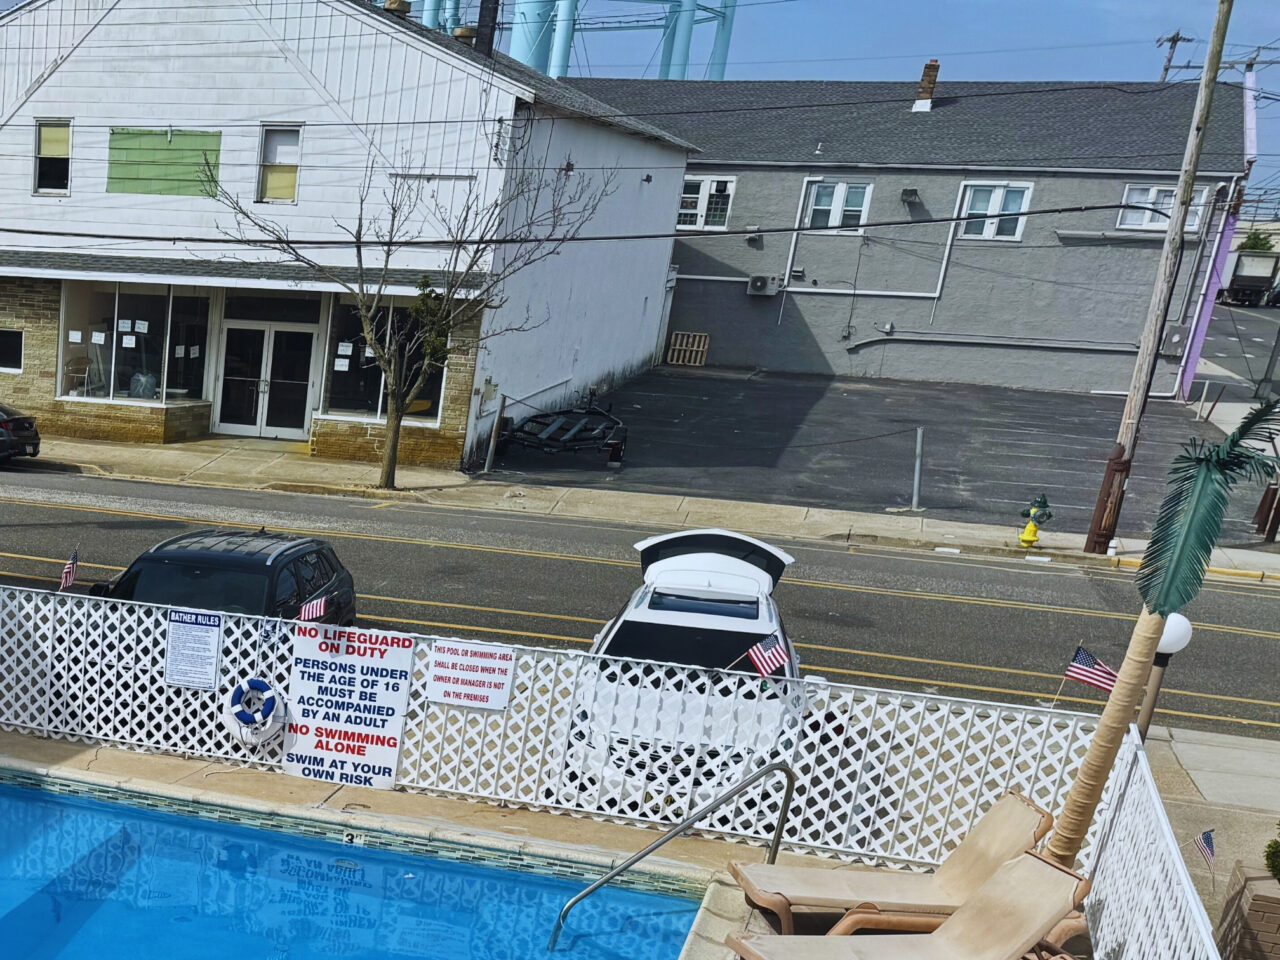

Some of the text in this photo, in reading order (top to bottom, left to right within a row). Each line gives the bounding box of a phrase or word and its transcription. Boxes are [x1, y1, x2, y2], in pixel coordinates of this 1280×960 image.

[170, 611, 219, 626] BATHER RULES
[297, 625, 413, 649] NO LIFEGUARD
[318, 641, 388, 659] ON DUTY
[434, 645, 513, 662] THIS POOL OR SWIMMING AREA
[294, 657, 409, 681] PERSONS UNDER
[433, 660, 509, 676] SHALL BE CLOSED WHEN THE
[299, 670, 400, 692] THE AGE OF 16
[433, 674, 505, 690] OWNER OR MANAGER IS NOT
[317, 685, 378, 702] MUST BE
[443, 690, 490, 703] ON THE PREMISES
[297, 695, 395, 717] ACCOMPANIED
[301, 708, 388, 729] BY AN ADULT
[288, 723, 398, 749] NO SWIMMING
[314, 739, 367, 756] ALONE
[286, 752, 393, 777] SWIM AT YOUR
[301, 767, 374, 787] OWN RISK
[345, 832, 355, 844] 3
